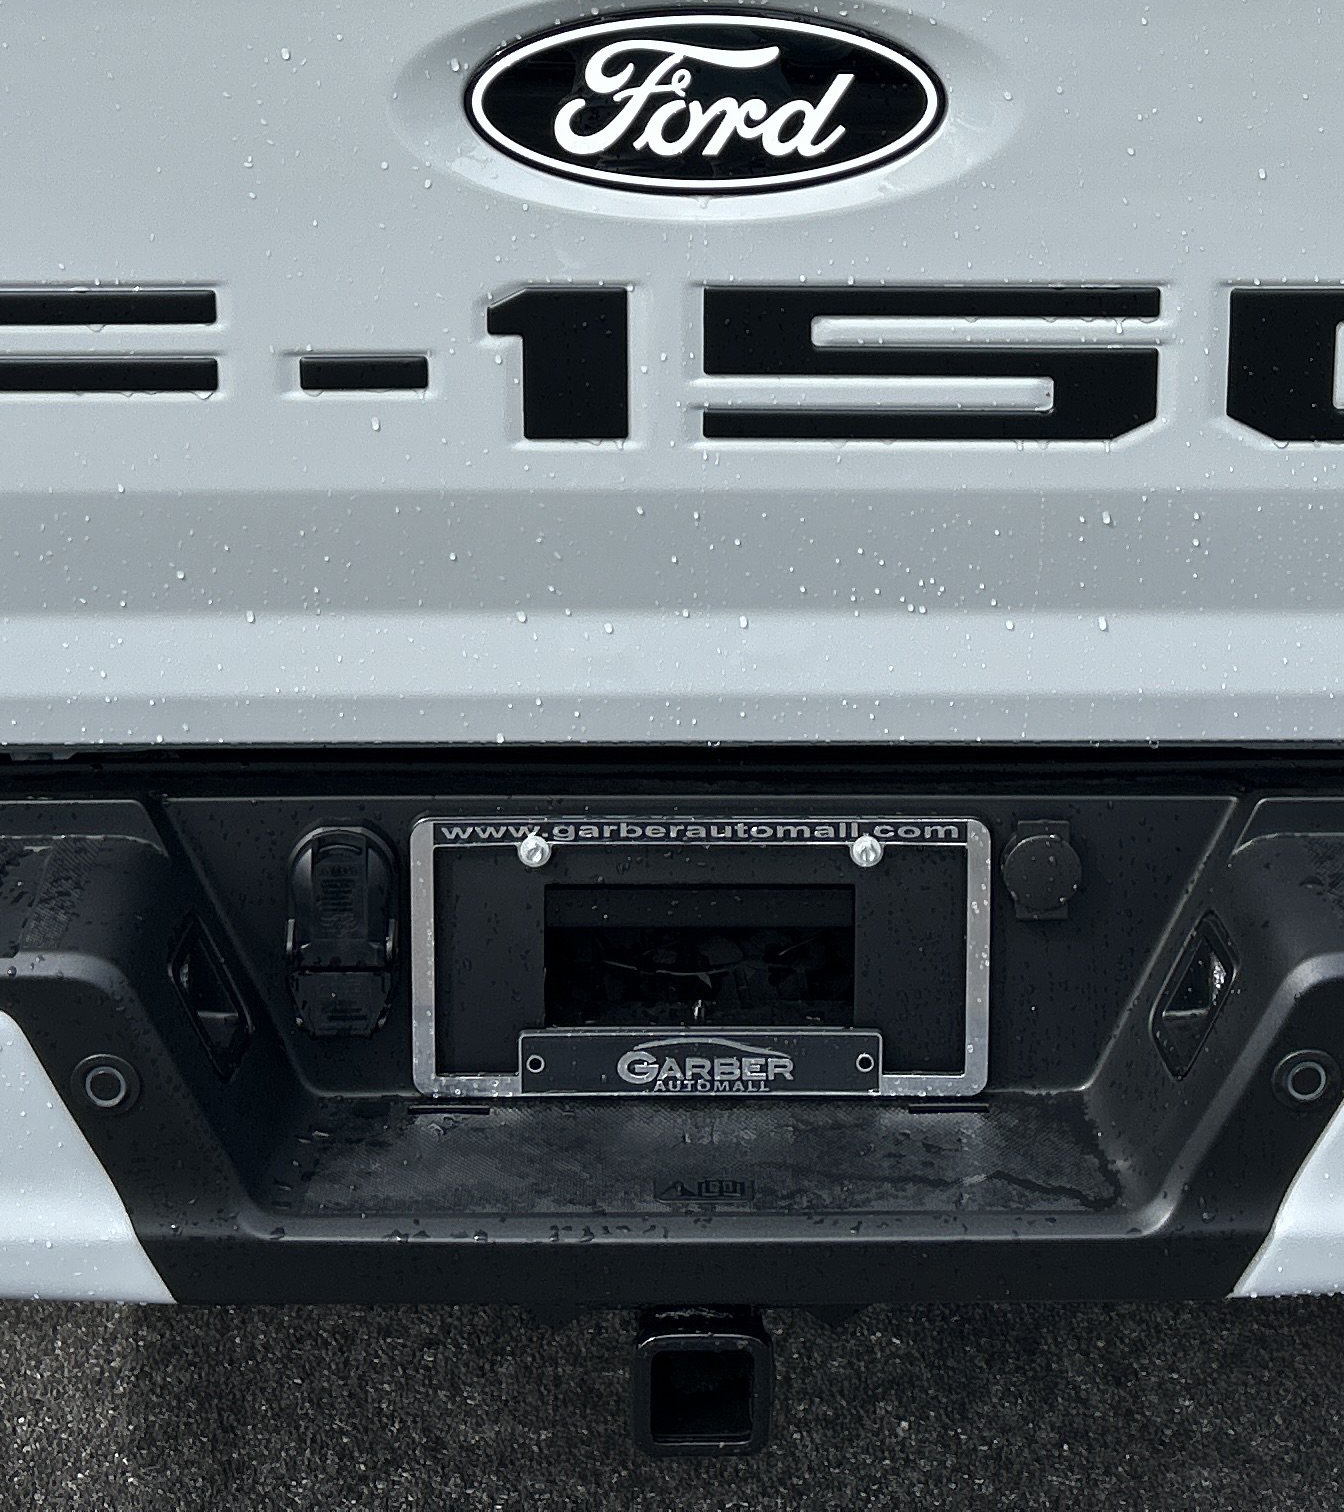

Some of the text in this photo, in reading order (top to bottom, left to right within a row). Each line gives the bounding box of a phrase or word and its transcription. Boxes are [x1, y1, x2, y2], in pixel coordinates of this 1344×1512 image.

[555, 39, 855, 157] Ford
[617, 1050, 794, 1085] GARBER
[653, 1080, 771, 1092] AUTOMALL
